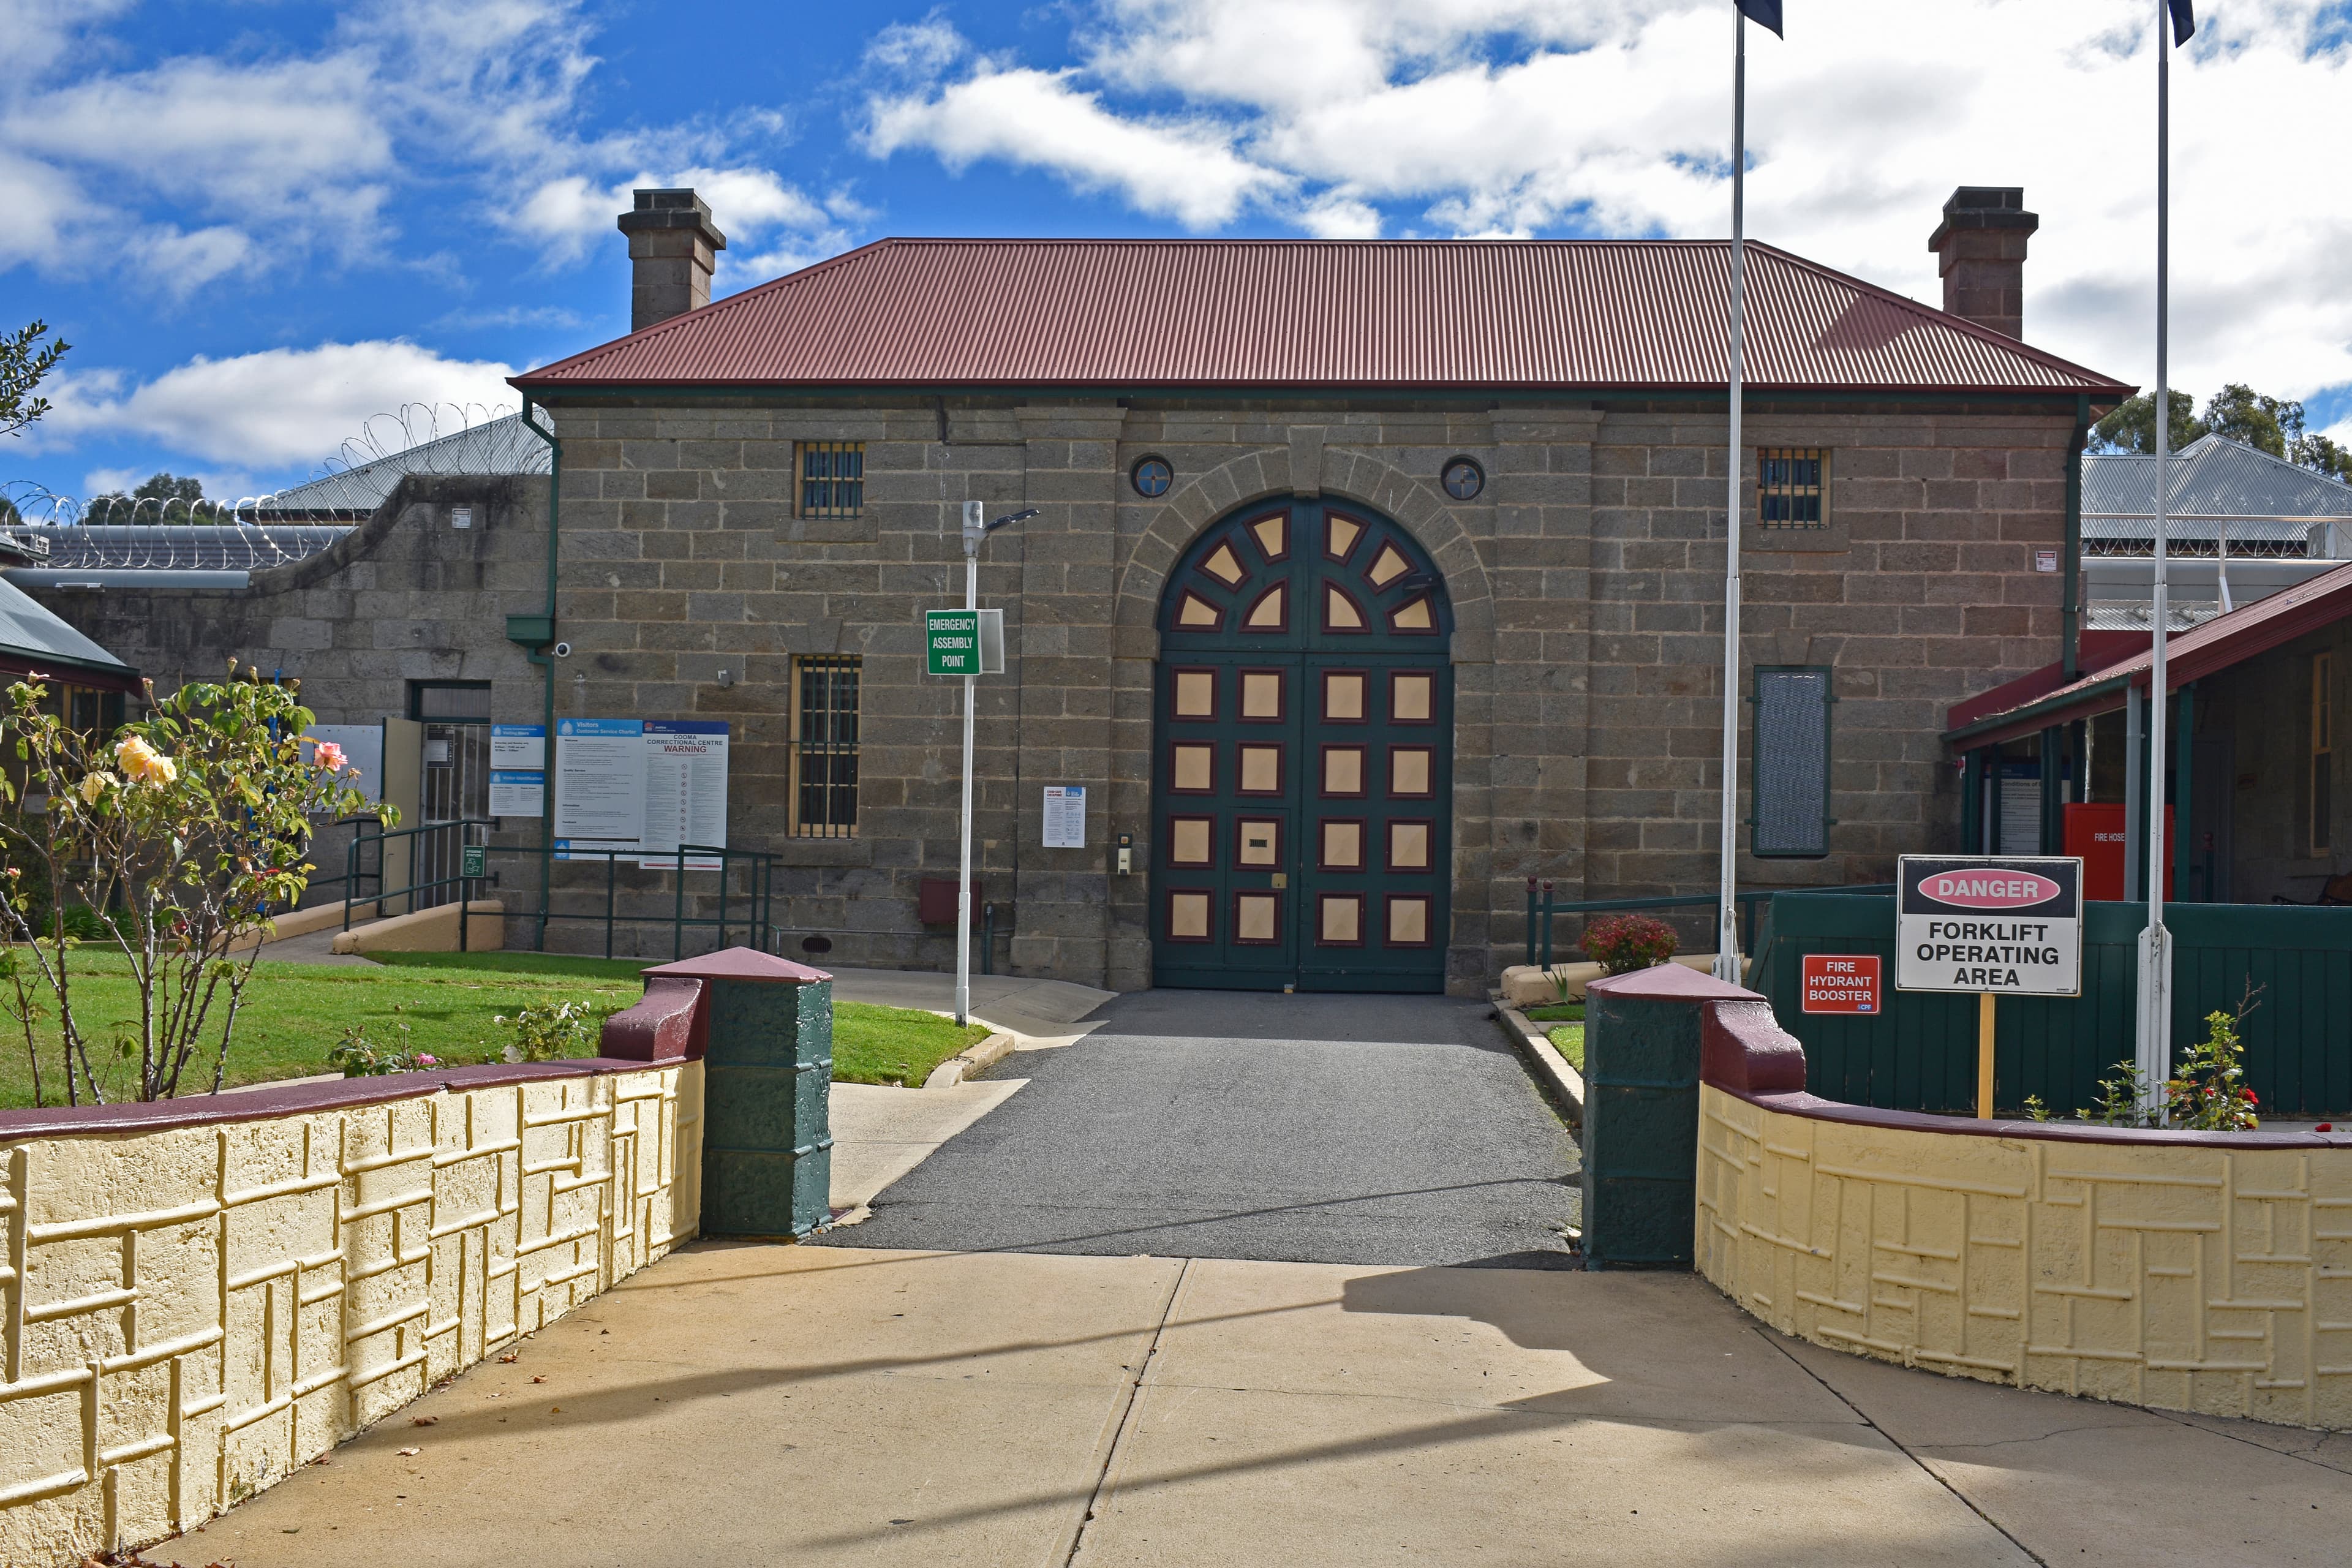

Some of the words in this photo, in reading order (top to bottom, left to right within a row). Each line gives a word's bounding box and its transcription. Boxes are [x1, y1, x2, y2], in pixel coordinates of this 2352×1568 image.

[929, 619, 975, 630] EMERGENCY
[933, 637, 973, 648] ASSEMBLY
[942, 655, 965, 666] POINT
[2095, 833, 2107, 842] FIRE
[2109, 833, 2125, 842] HOSE
[1939, 880, 2038, 898] DANGER
[1929, 922, 2048, 942] FORKLIFT
[1917, 944, 2059, 965] OPERATING
[1826, 962, 1855, 972] FIRE
[1809, 976, 1872, 987] HYDRANT
[1953, 968, 2020, 986] AREA
[1809, 990, 1872, 1001] BOOSTER
